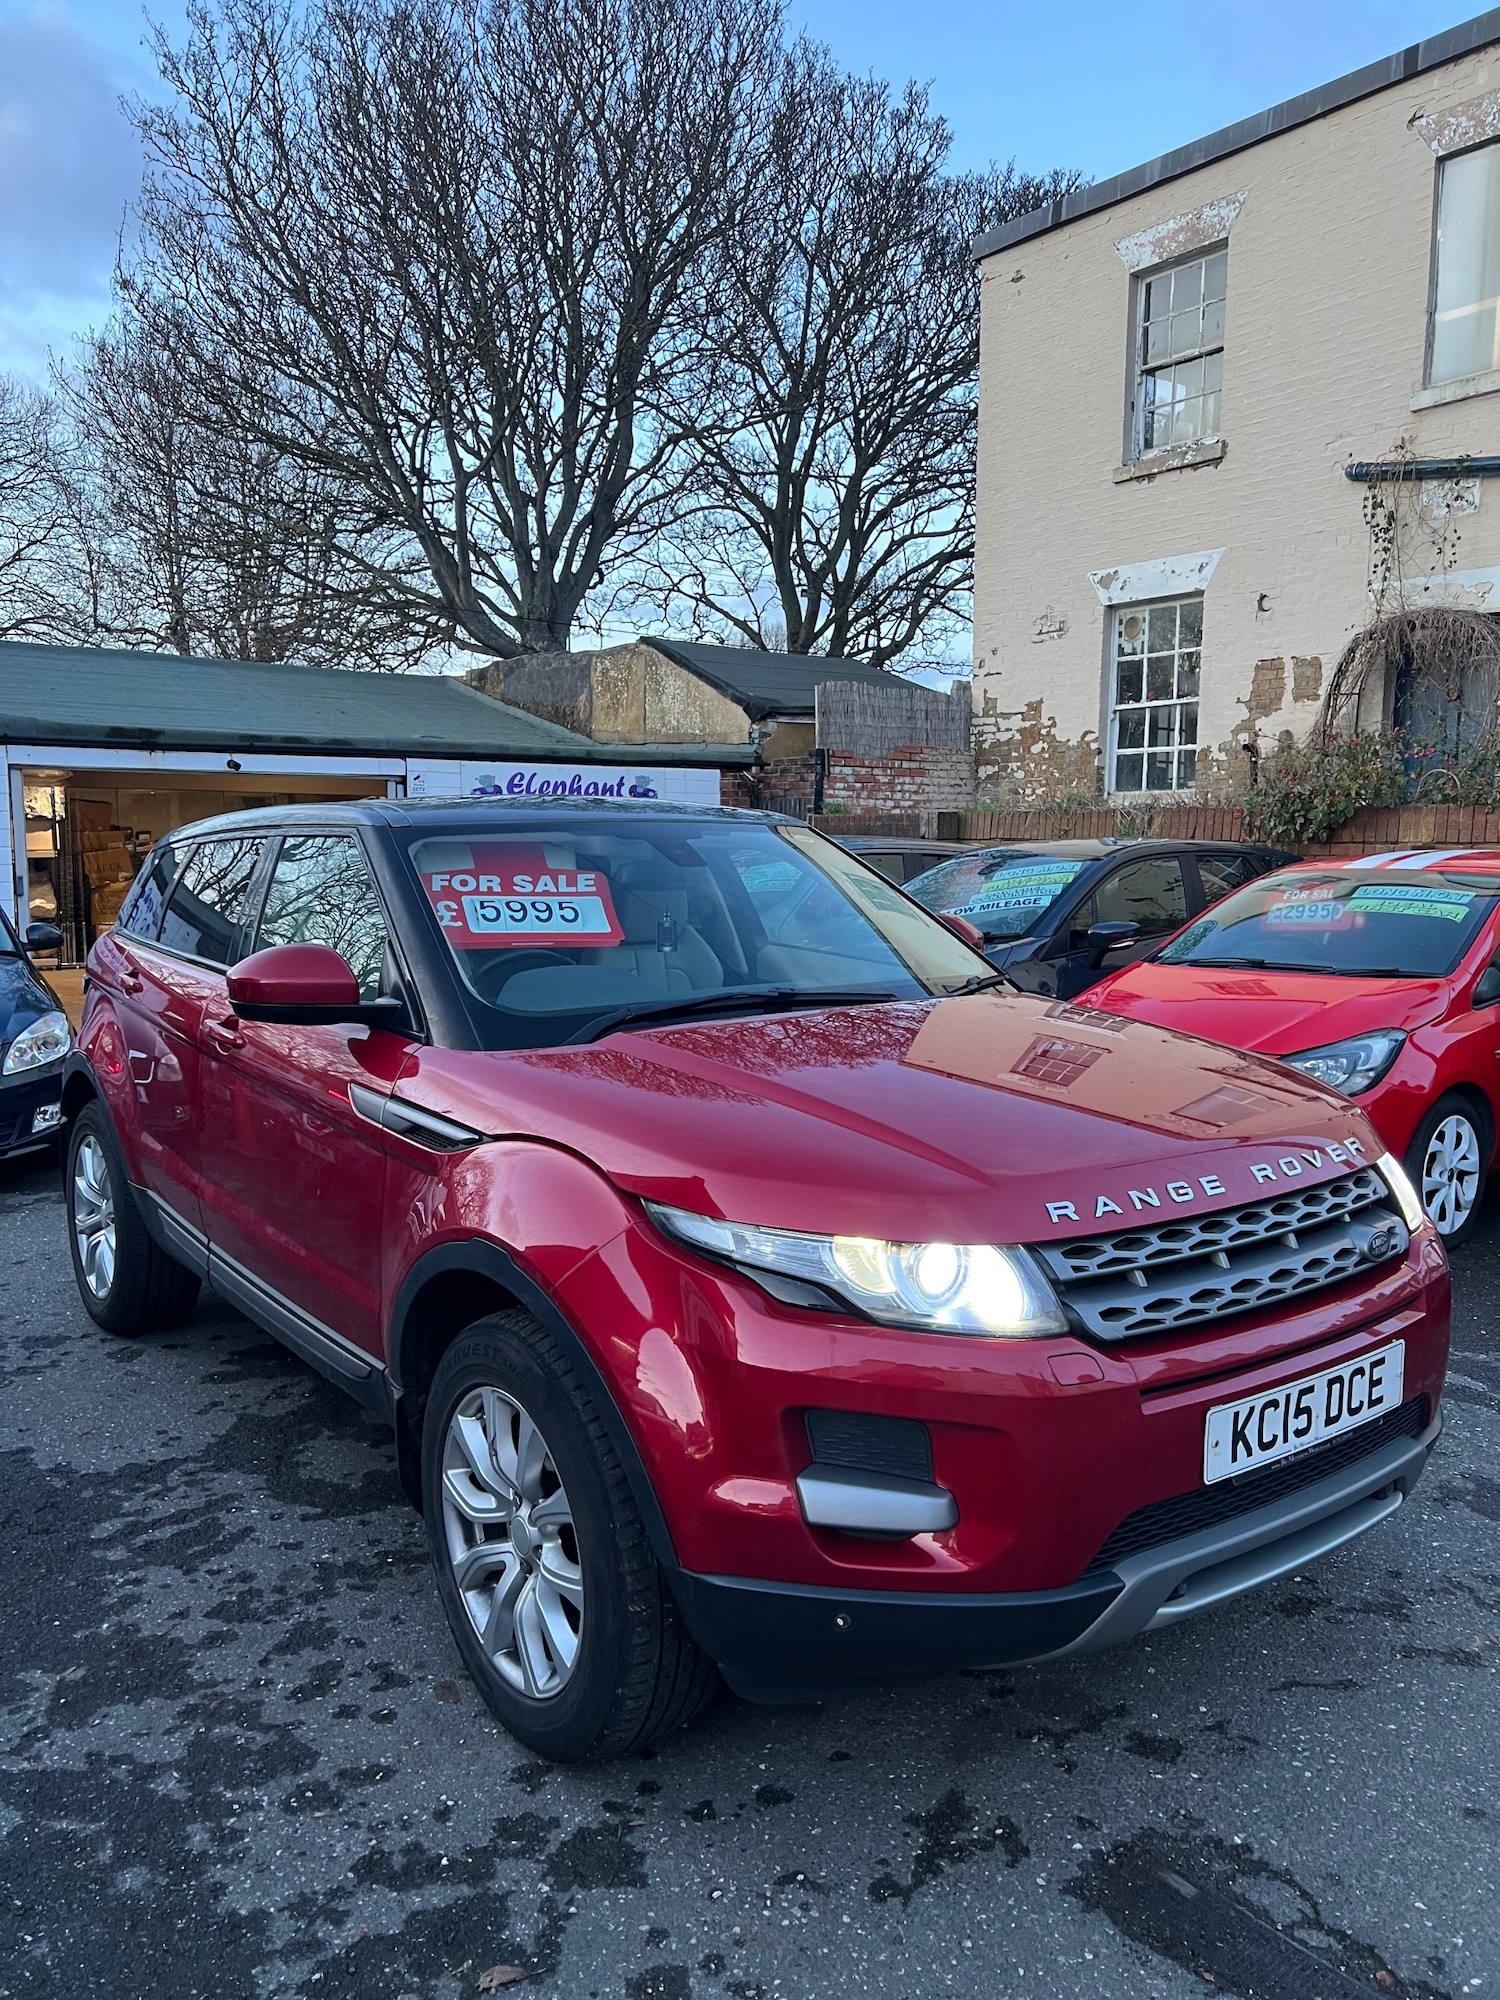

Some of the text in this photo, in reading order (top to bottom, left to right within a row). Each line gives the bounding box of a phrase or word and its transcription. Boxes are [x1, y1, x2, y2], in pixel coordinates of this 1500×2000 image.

[507, 772, 625, 796] Elephant
[997, 868, 1034, 878] LONG
[432, 873, 596, 893] FOR SALE
[1283, 889, 1335, 900] FOR SAL
[1358, 887, 1409, 897] LONG
[979, 897, 1042, 911] MILEAGE
[1352, 904, 1408, 913] FIRST
[1376, 900, 1437, 910] IDEAL
[479, 900, 580, 923] 5995
[1045, 1137, 1366, 1223] RANGE ROVER
[1231, 1384, 1317, 1463] KC15
[1324, 1356, 1387, 1428] DCE
